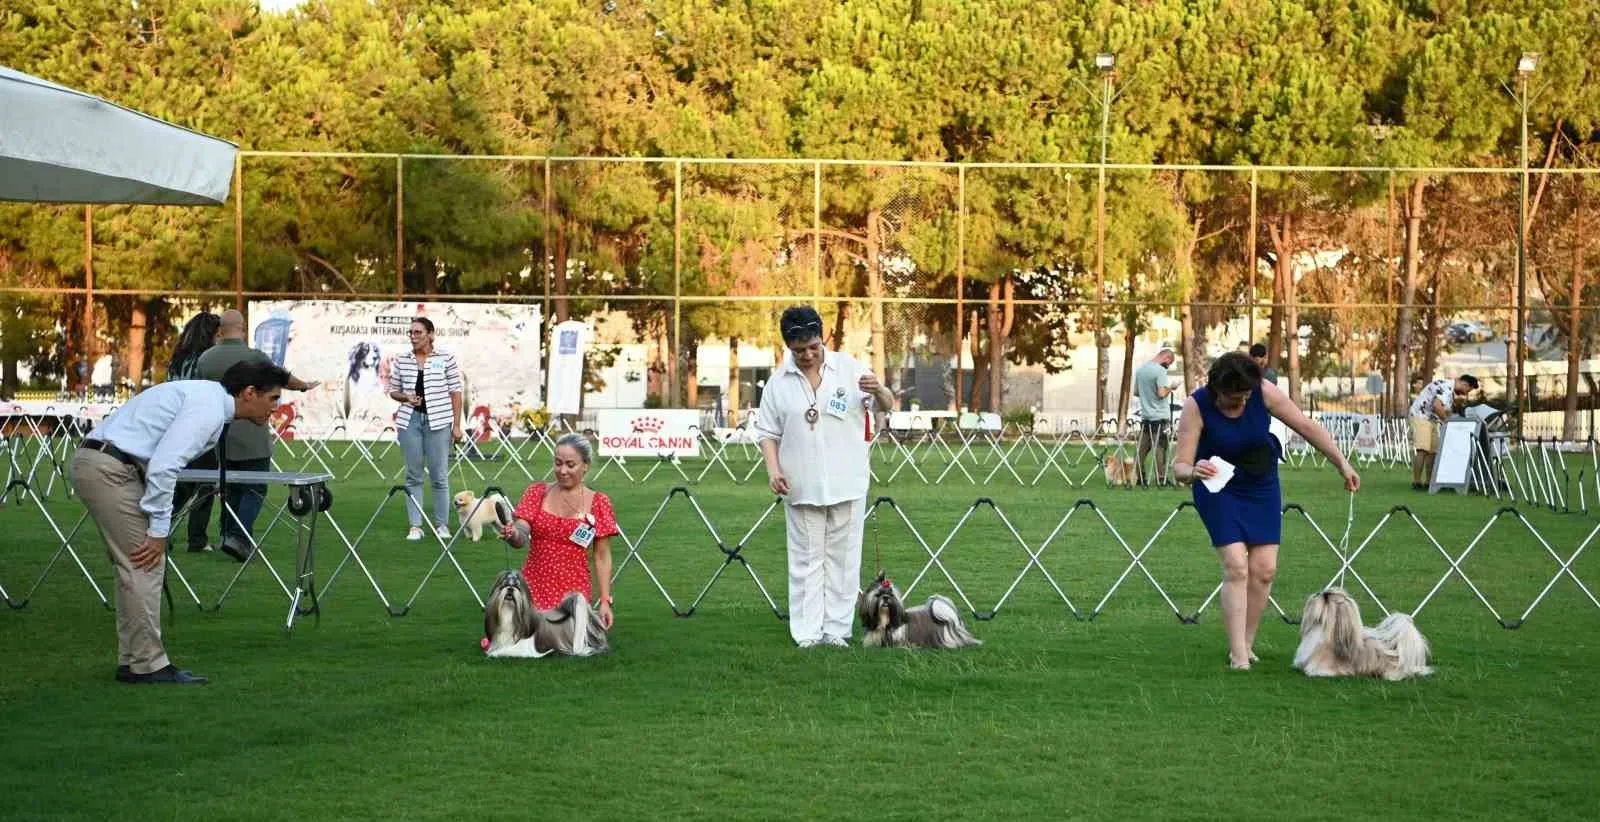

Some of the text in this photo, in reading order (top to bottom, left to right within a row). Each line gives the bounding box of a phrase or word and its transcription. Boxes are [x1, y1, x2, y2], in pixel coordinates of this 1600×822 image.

[330, 325, 368, 336] KUŞADASI
[448, 327, 470, 336] SHOW
[830, 399, 846, 411] 083
[603, 437, 692, 448] ROYAL CANIN
